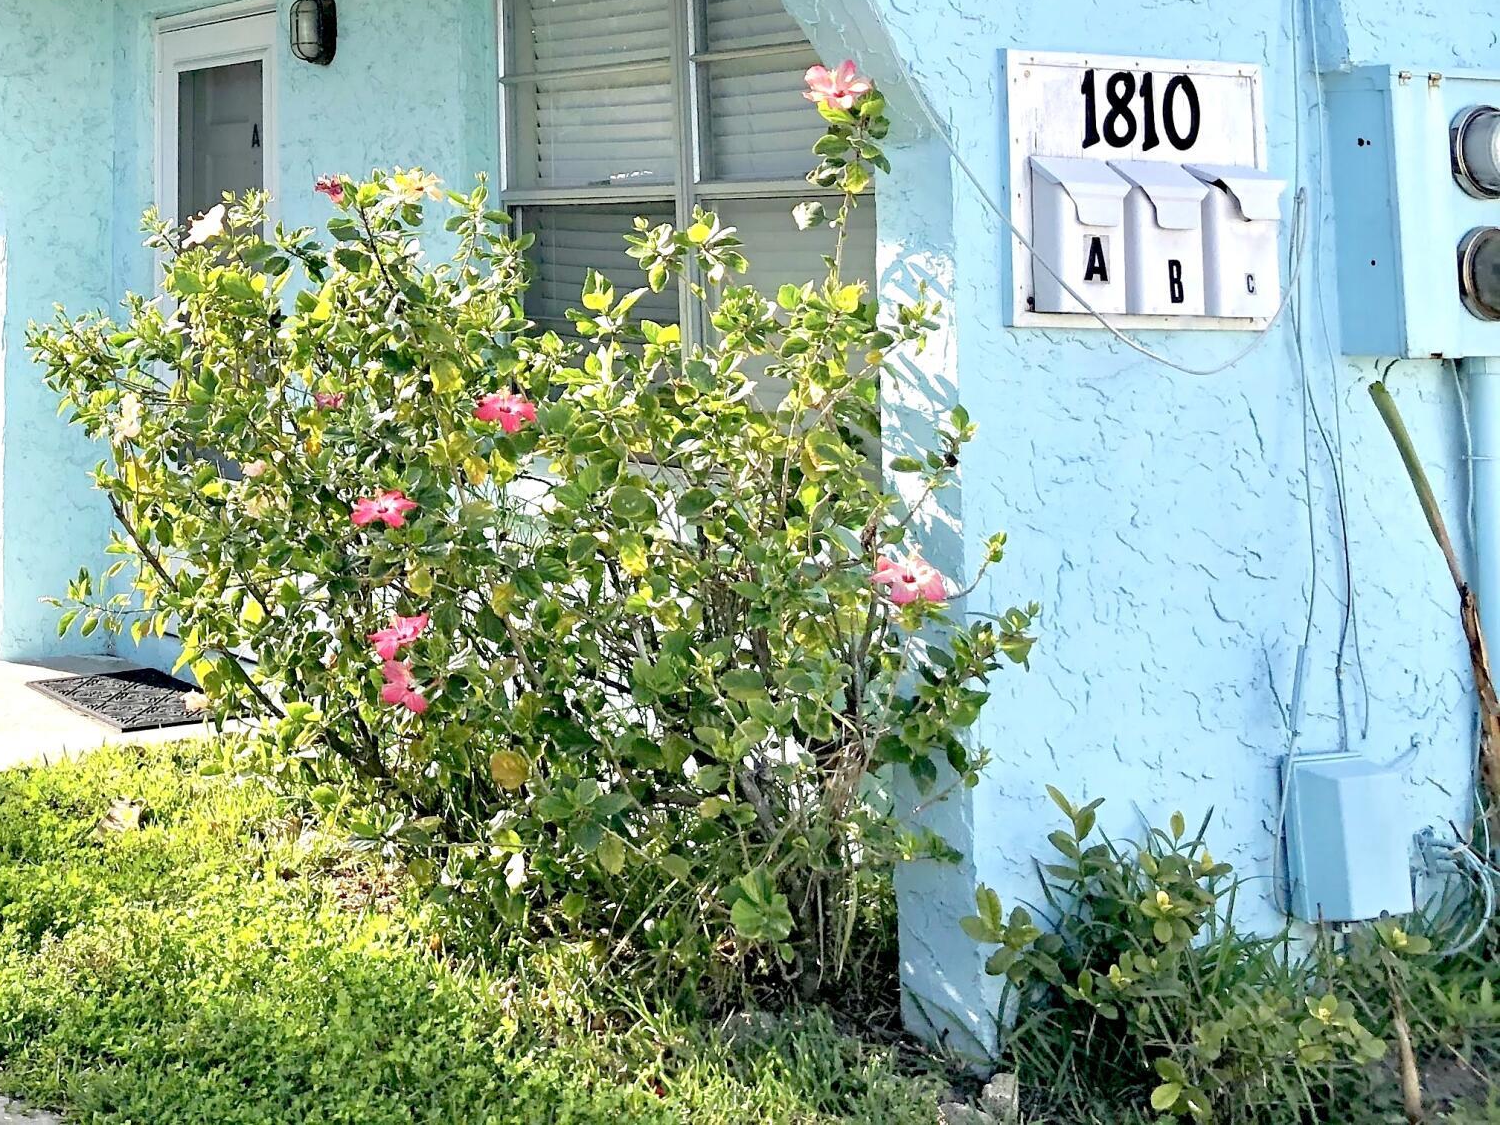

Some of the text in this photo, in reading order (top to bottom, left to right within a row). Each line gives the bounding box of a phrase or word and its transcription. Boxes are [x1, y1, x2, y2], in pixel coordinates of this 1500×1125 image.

[1081, 69, 1201, 151] 1810
[251, 123, 260, 148] A
[1083, 236, 1109, 282] A
[1168, 259, 1184, 304] B
[1245, 274, 1256, 294] C
